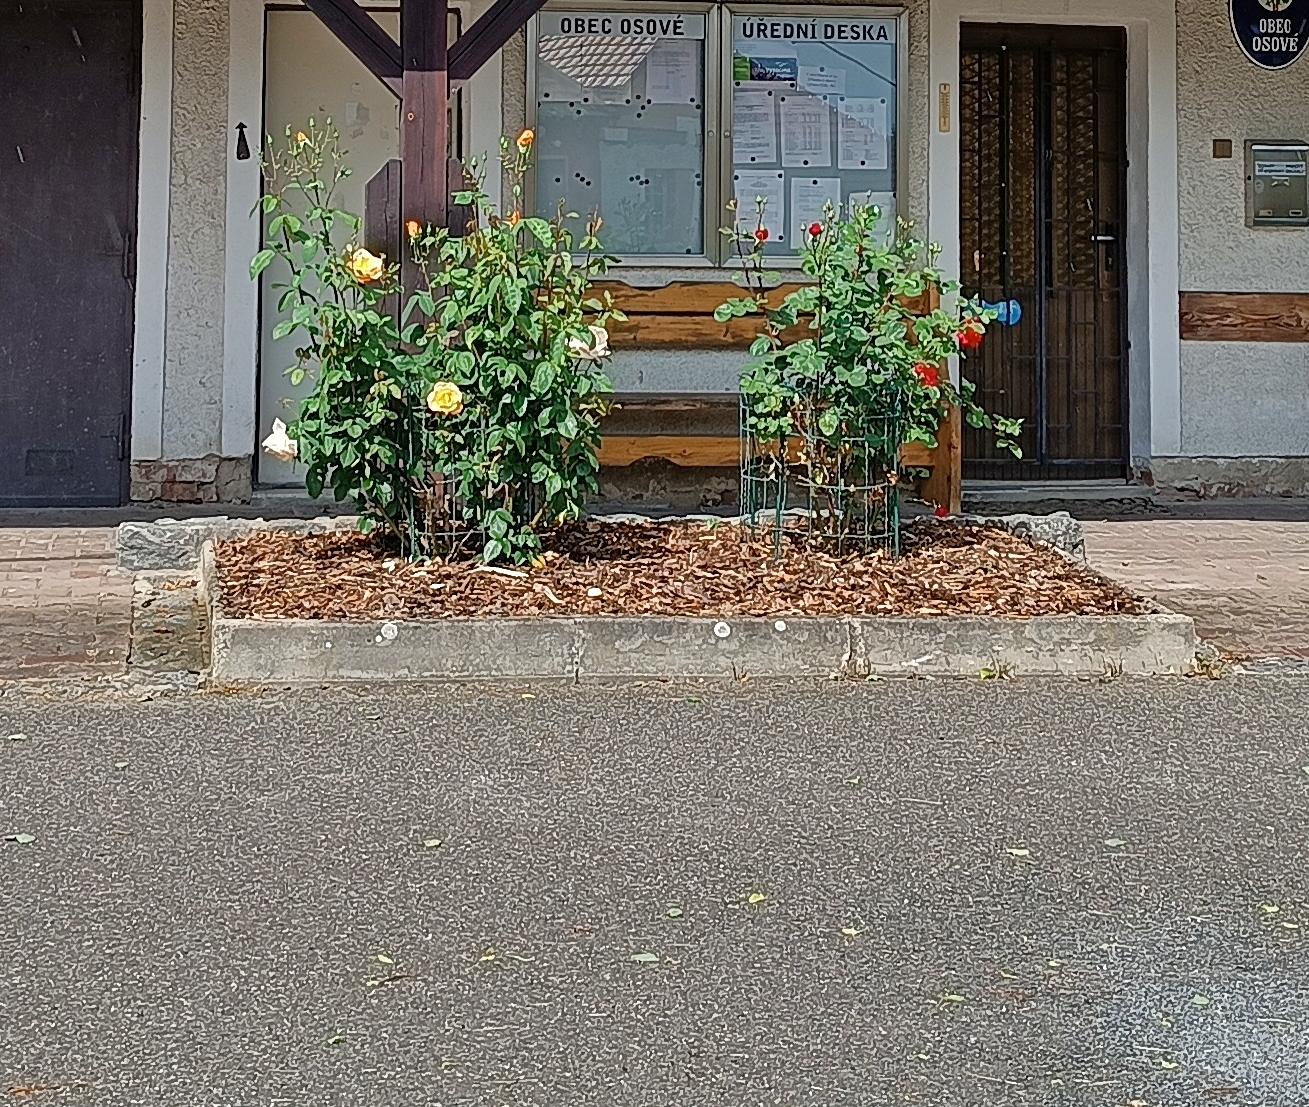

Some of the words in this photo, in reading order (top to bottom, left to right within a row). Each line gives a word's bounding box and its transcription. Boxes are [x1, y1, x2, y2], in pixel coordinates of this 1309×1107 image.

[560, 17, 613, 35] OBEC
[620, 13, 685, 36] OSOVÉ
[742, 16, 818, 40] ÚŘEDNÍ
[823, 23, 889, 41] DESKA
[1252, 32, 1299, 52] OSOVÉ
